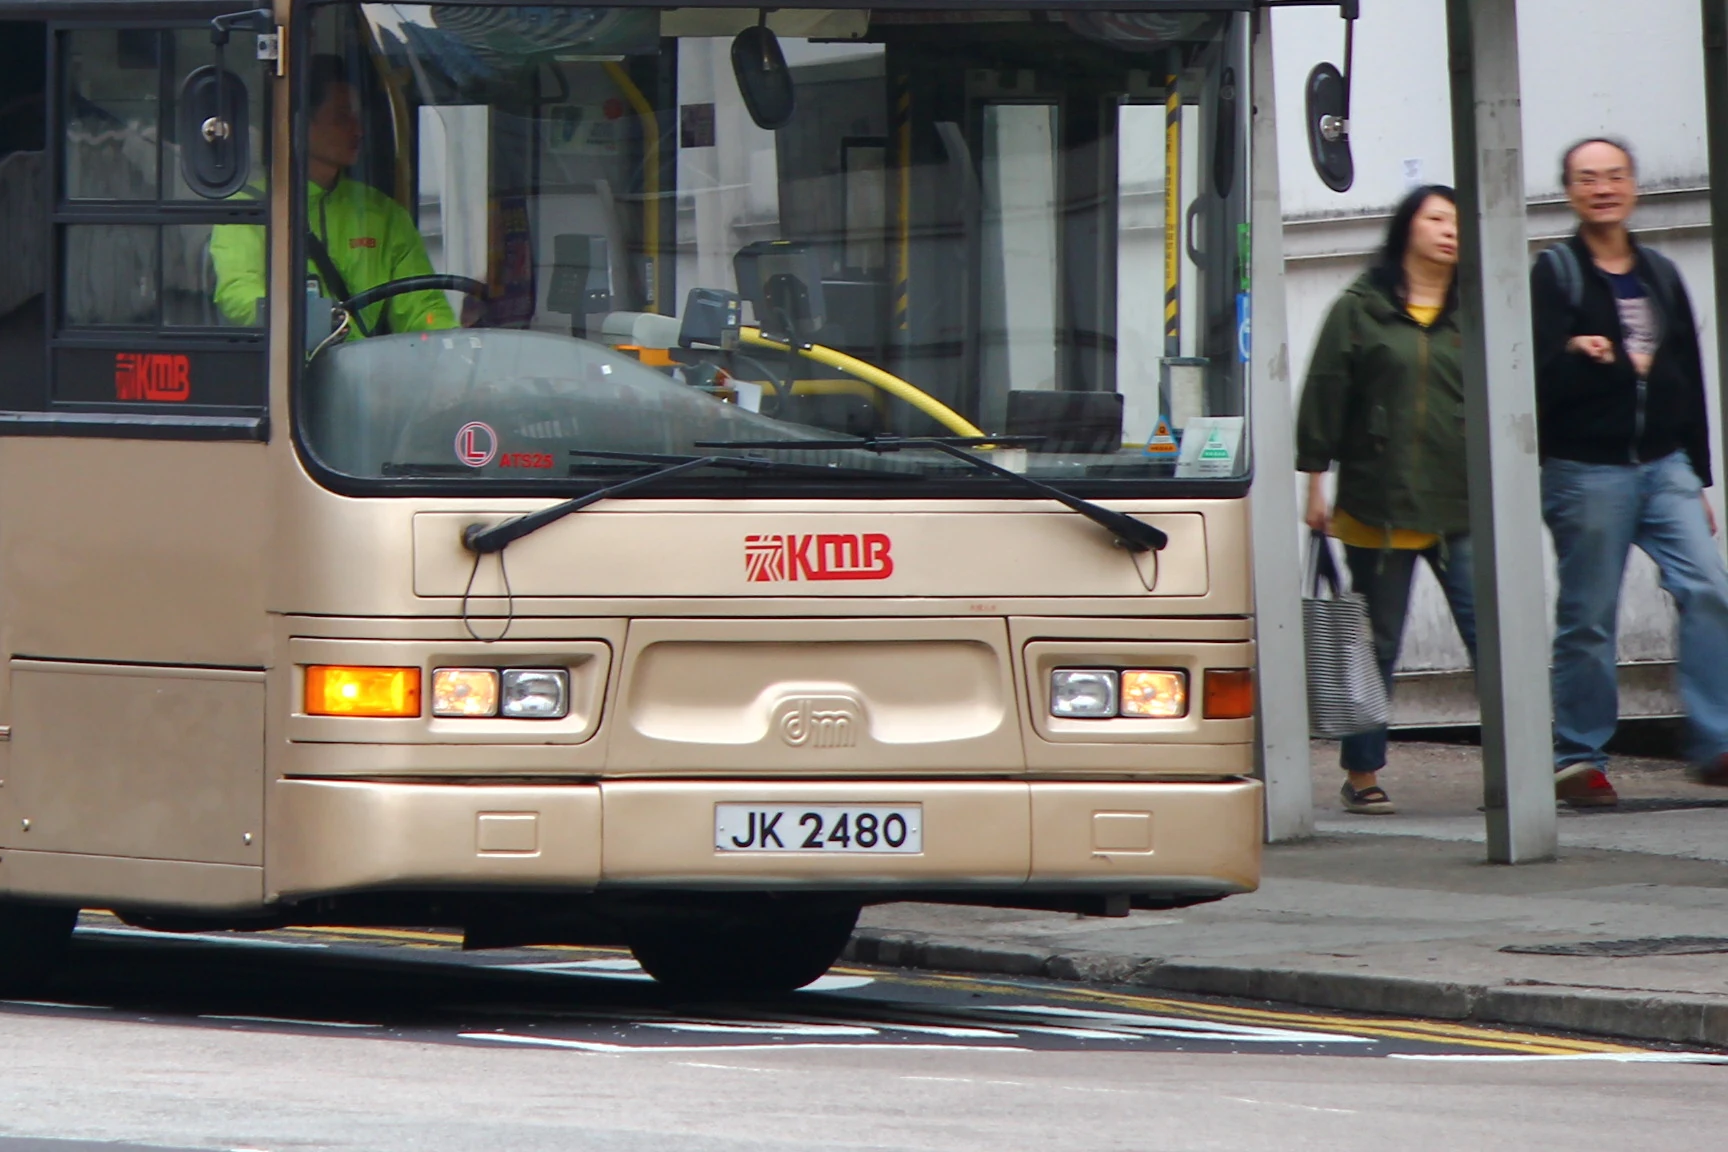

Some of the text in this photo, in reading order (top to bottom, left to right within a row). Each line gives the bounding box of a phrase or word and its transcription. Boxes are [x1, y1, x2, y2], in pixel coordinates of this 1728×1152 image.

[498, 452, 555, 470] ATS25
[787, 533, 894, 582] KMB
[731, 811, 907, 849] JK 2480
